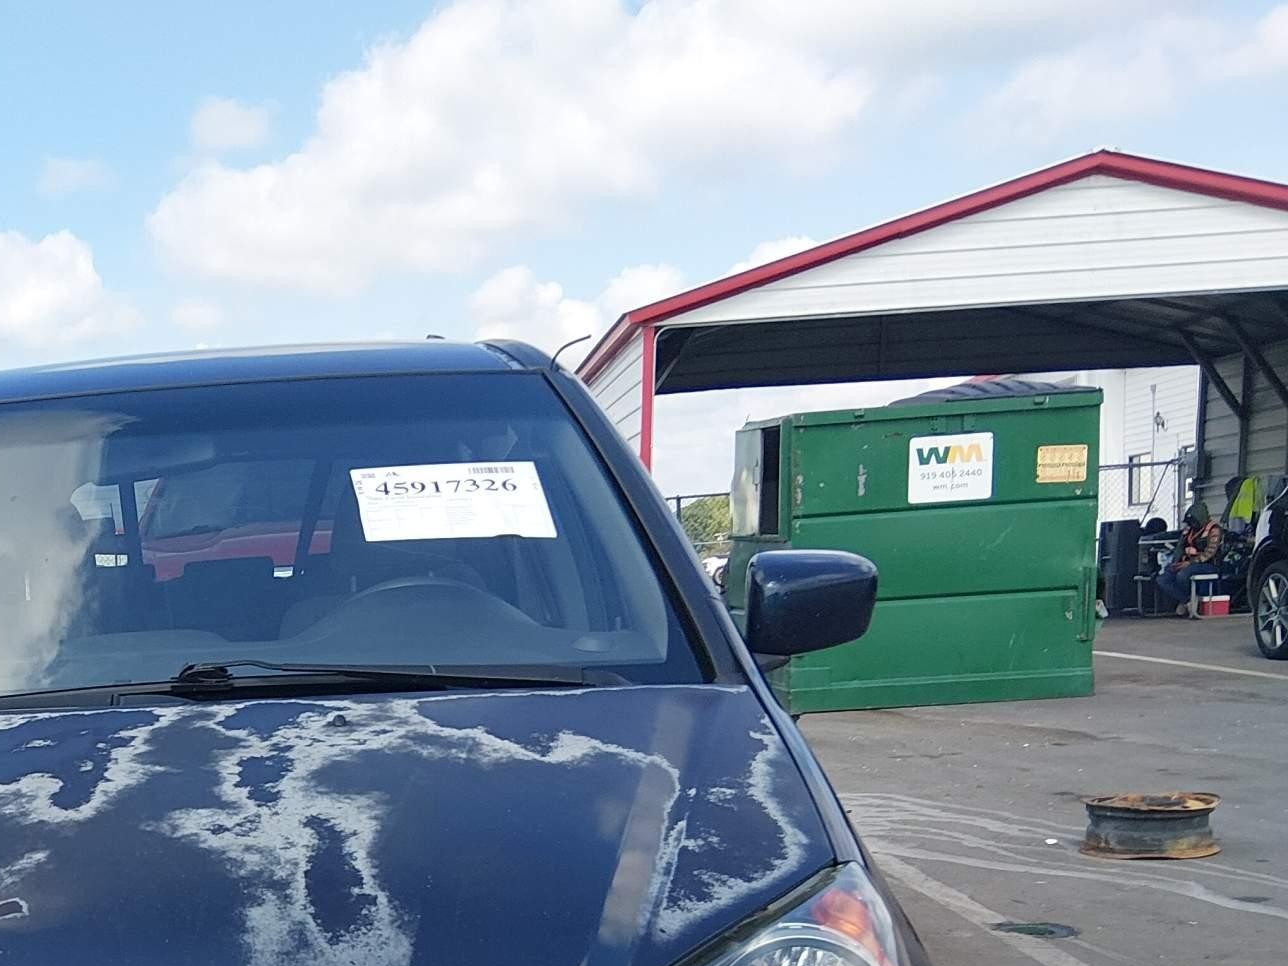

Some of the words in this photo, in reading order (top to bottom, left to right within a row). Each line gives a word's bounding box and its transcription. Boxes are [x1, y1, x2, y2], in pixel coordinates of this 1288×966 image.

[916, 444, 984, 465] WM
[920, 471, 937, 480] 919
[959, 468, 983, 478] 2440
[375, 478, 518, 496] 45917326
